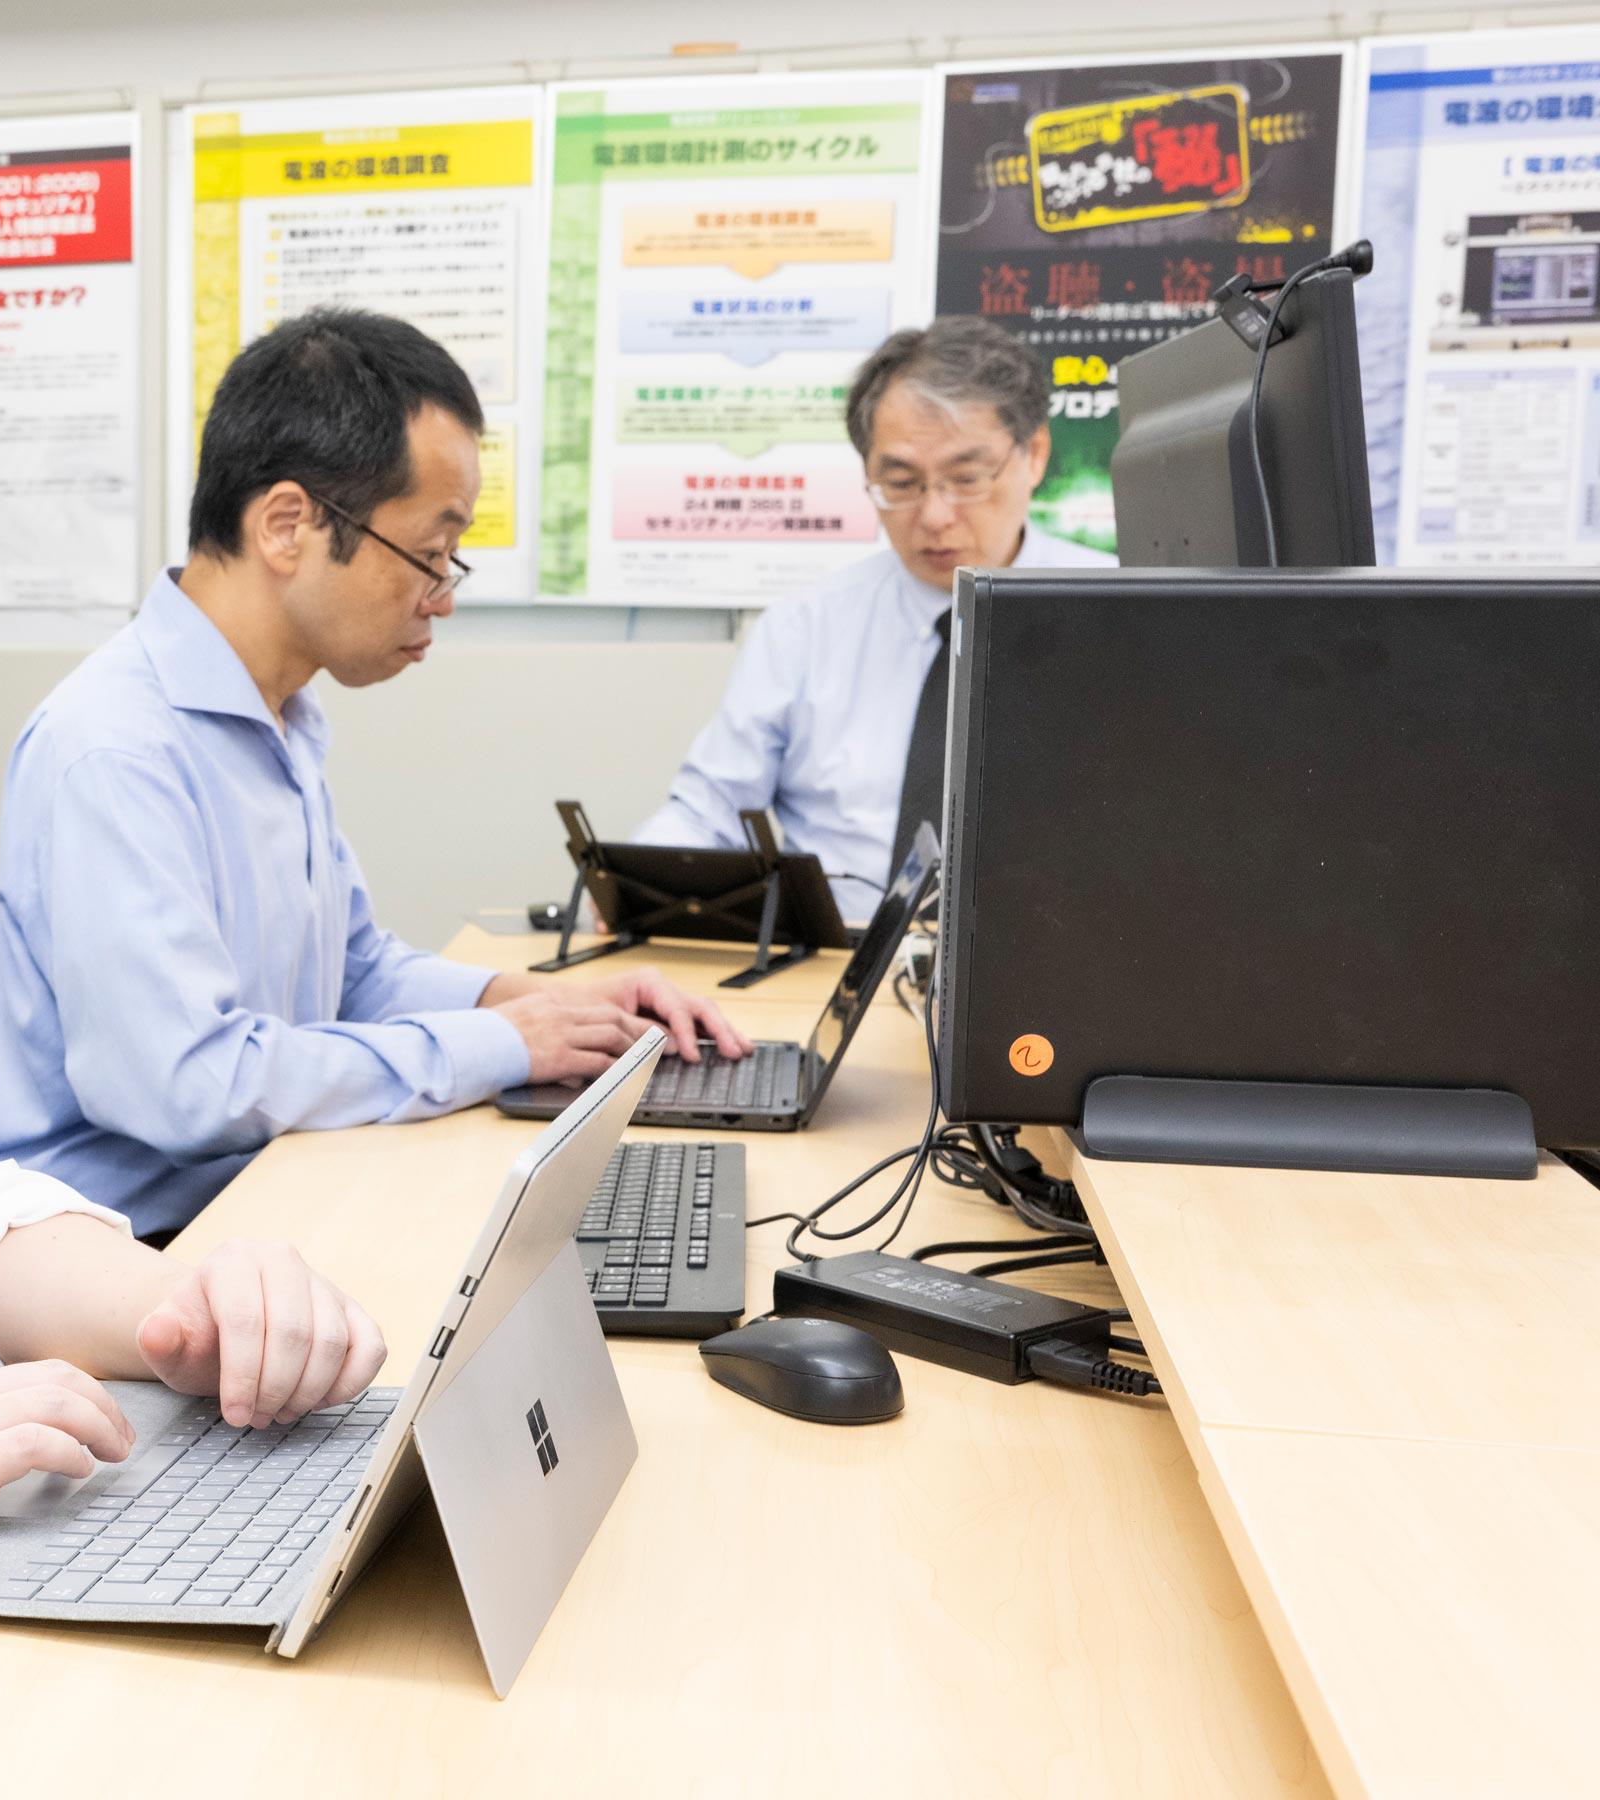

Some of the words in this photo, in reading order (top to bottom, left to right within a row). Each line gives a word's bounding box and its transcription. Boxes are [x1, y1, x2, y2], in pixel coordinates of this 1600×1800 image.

[1445, 95, 1600, 125] 電波の環境
[592, 135, 879, 167] 電波環境計測のサイクル
[284, 153, 450, 181] 電波の環境調査
